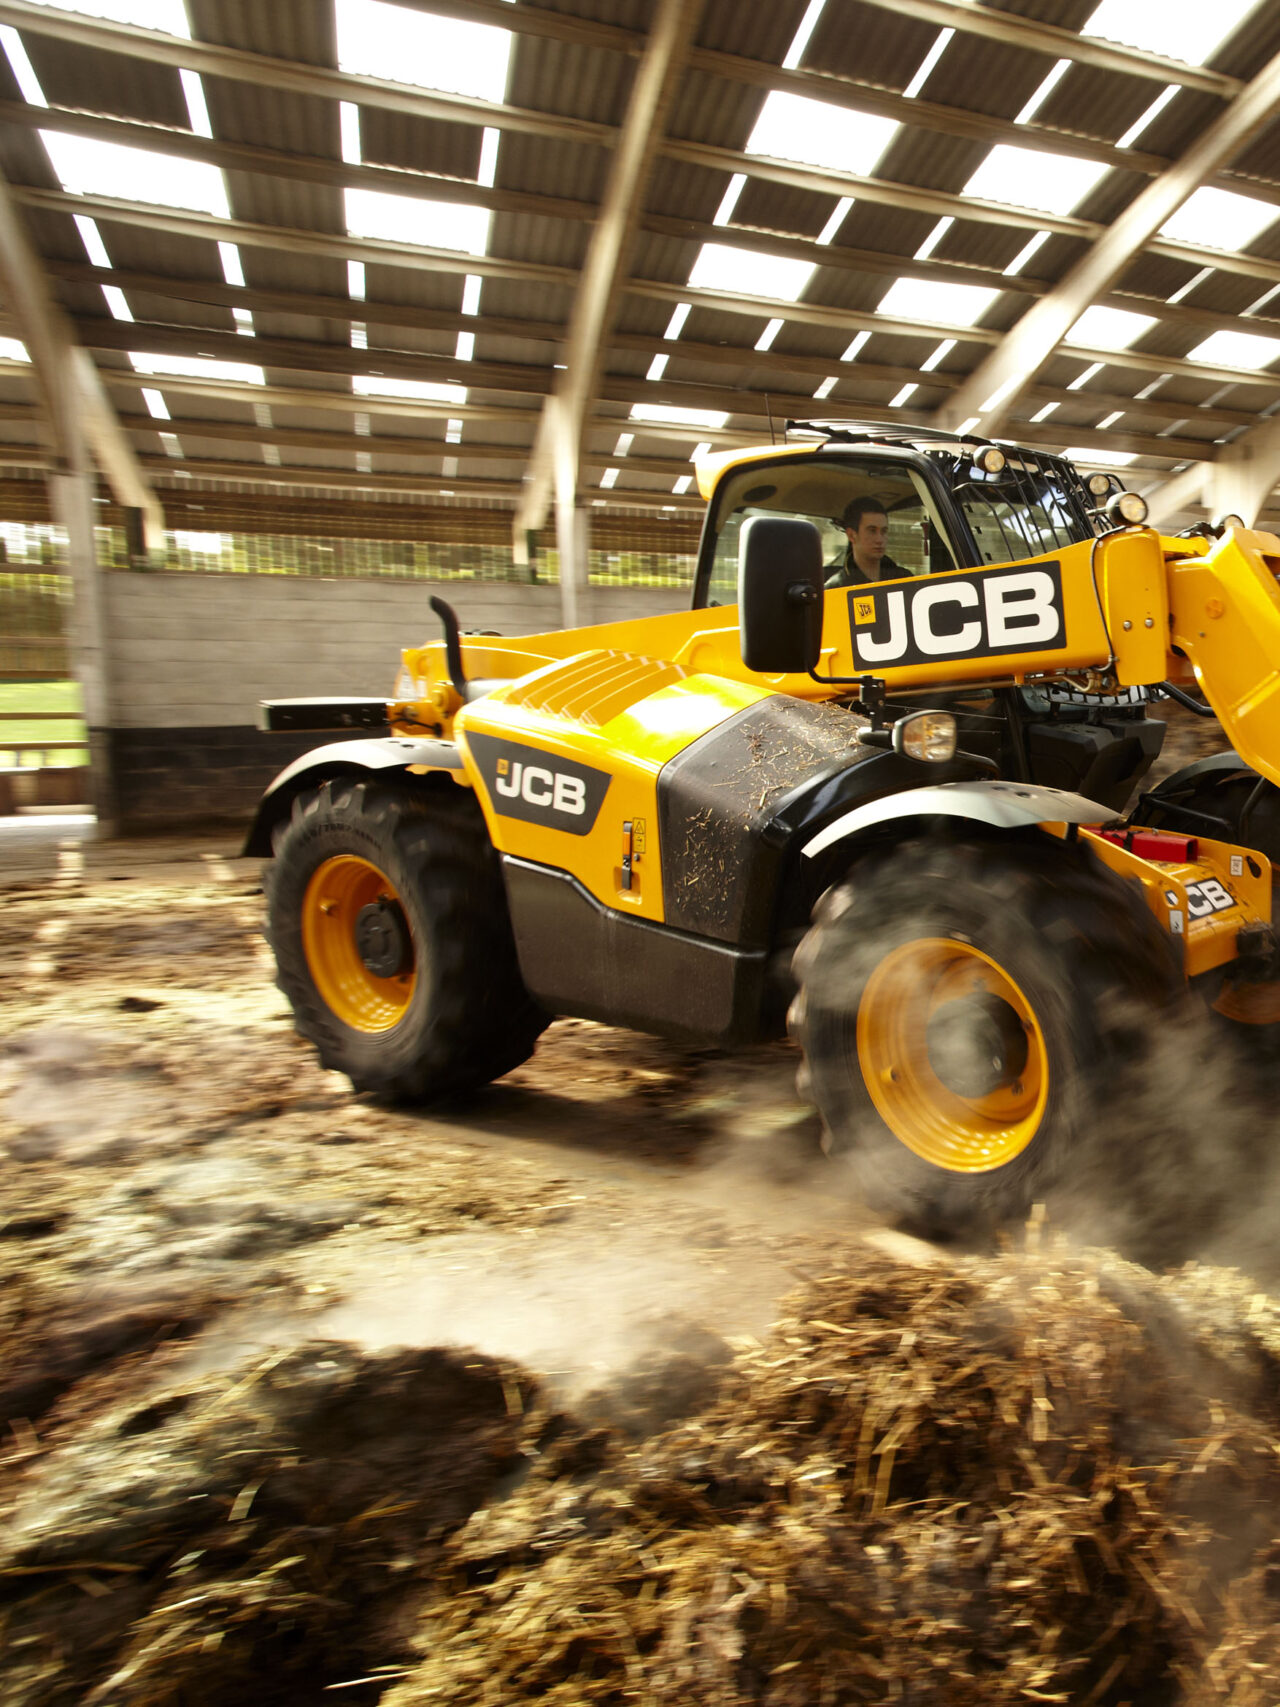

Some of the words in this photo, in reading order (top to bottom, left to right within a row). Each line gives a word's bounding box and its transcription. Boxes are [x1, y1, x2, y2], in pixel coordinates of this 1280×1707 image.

[856, 571, 1060, 662] JCB
[495, 762, 586, 816] JCB
[1184, 880, 1234, 917] CB
